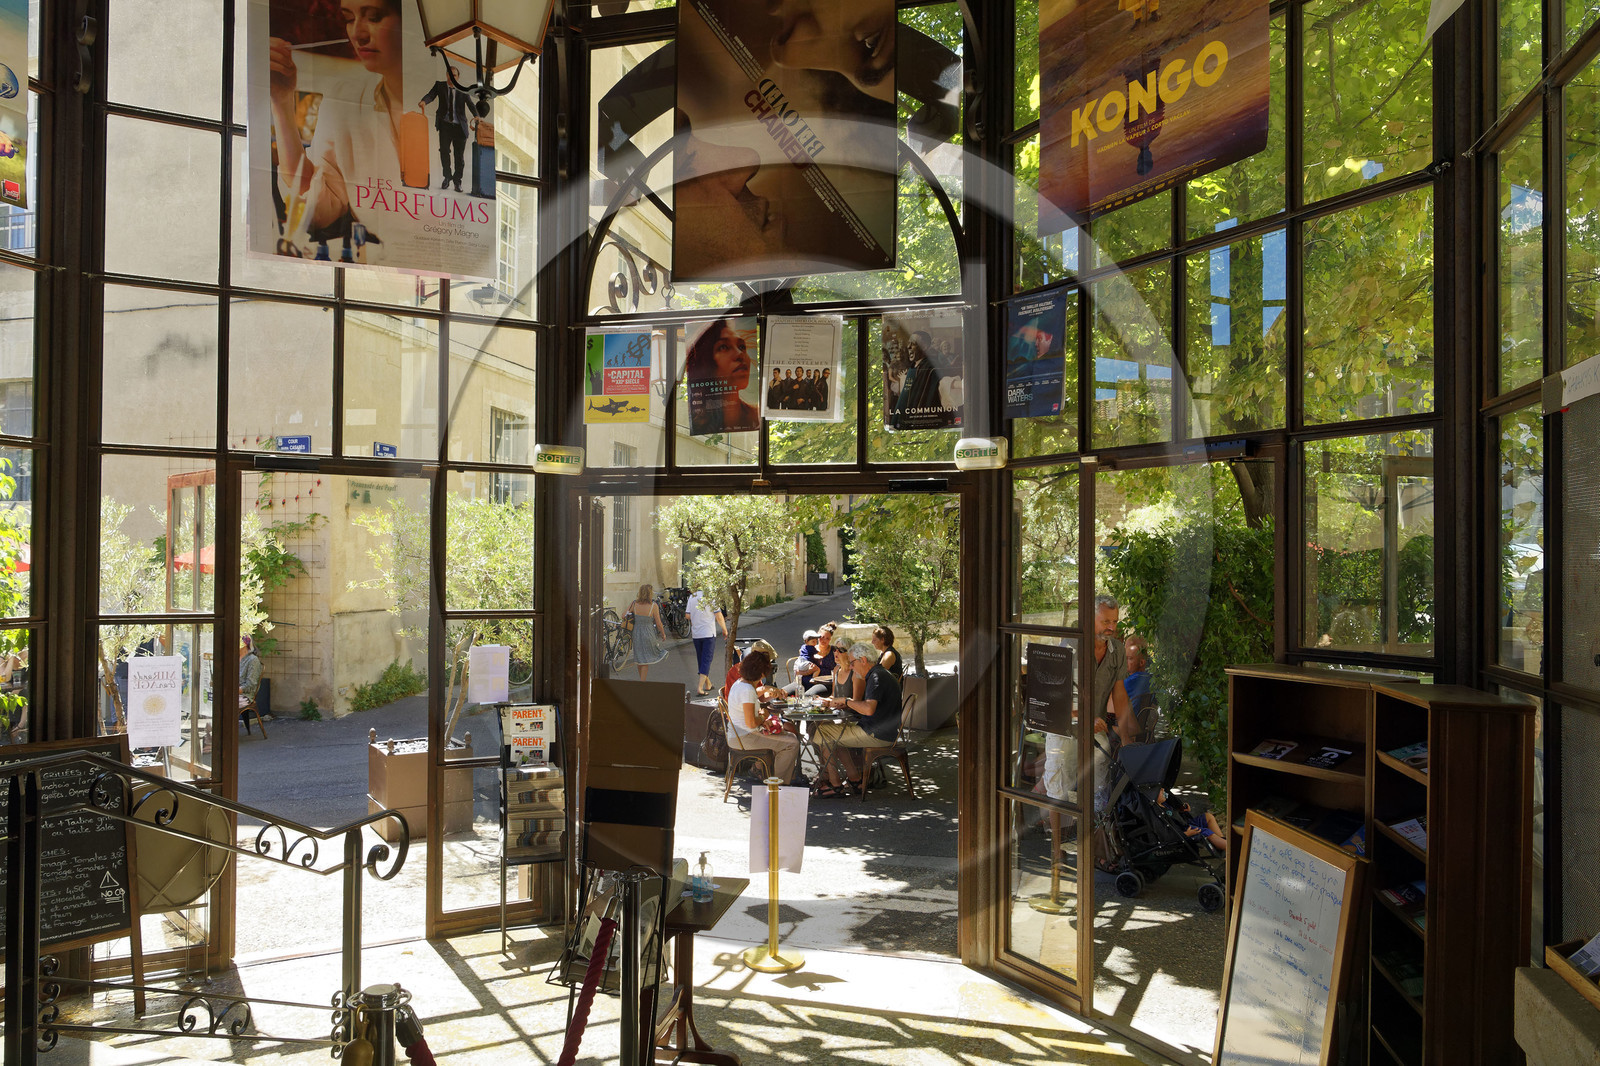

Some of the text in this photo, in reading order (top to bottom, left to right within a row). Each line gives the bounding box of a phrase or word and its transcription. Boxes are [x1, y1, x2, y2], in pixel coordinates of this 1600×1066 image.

[1070, 40, 1228, 148] KONGO
[758, 78, 826, 159] BELOVED
[744, 89, 811, 170] CHAINED
[368, 177, 393, 191] LES
[356, 185, 490, 224] PARFUMS
[423, 224, 480, 239] Grégory Magne
[611, 370, 644, 379] CAPITAL
[691, 380, 728, 388] BROOKLYN
[1008, 388, 1025, 396] DARK
[1007, 394, 1034, 403] WATERS
[905, 406, 959, 414] COMMUNION
[956, 447, 998, 458] SORTIE
[537, 453, 581, 464] SORTIE
[100, 890, 113, 898] NO
